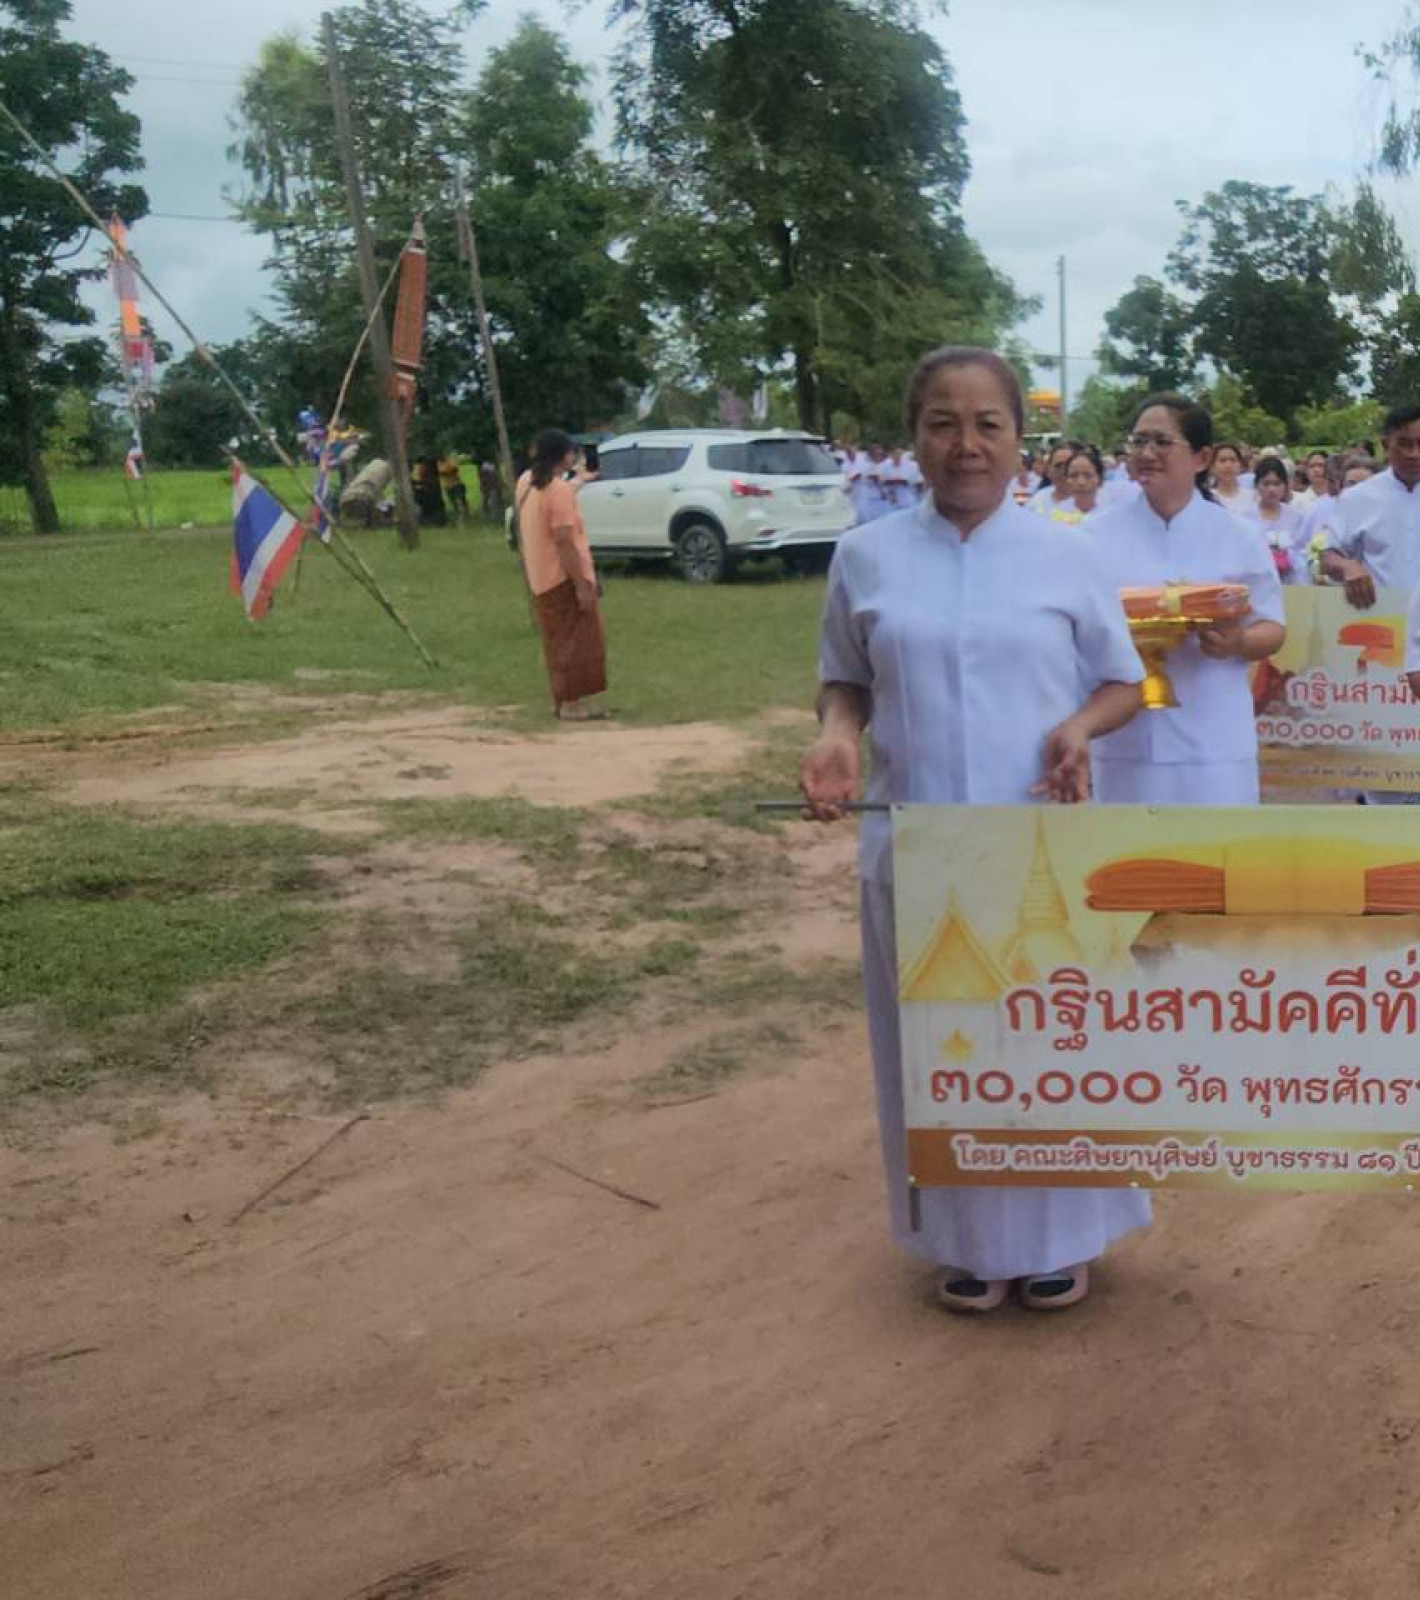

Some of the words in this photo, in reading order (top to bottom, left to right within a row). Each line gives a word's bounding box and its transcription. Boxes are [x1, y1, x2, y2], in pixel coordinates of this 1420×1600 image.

[1291, 671, 1416, 709] กฐินสามั
[1359, 719, 1382, 741] วัด
[930, 1069, 1162, 1111] ๓๐,๐๐๐
[1177, 1063, 1228, 1103] วัด
[957, 1139, 1005, 1166] โดย
[1013, 1140, 1219, 1176] คณะศิษยานุศิษย์
[1227, 1147, 1349, 1177] บูชาธรรม
[1357, 1151, 1396, 1170] ๘๑
